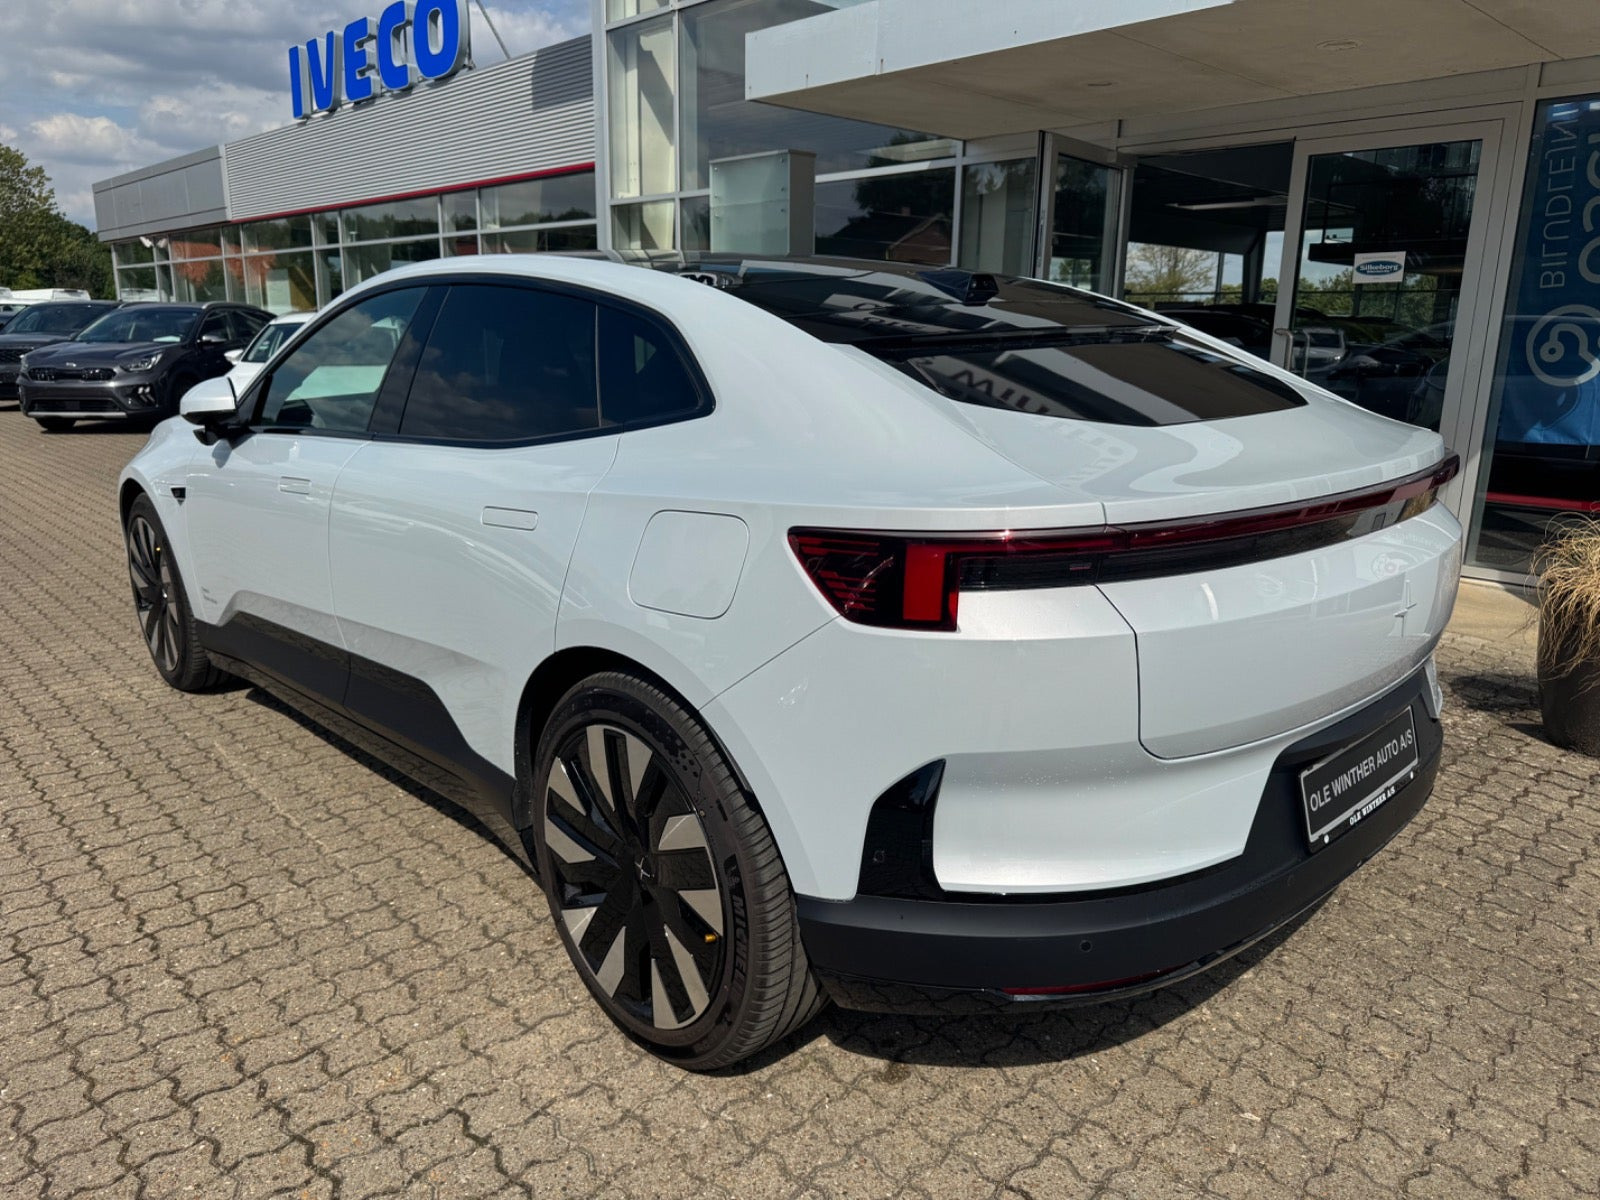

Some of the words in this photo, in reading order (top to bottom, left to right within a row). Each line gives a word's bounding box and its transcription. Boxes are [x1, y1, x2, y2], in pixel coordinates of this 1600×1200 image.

[289, 0, 462, 119] IVECO
[1310, 784, 1331, 812] OLE
[1331, 756, 1376, 797] WINTHER
[1376, 739, 1399, 769] AUTO
[1400, 728, 1413, 750] A/S
[1349, 810, 1362, 826] OLE
[1361, 792, 1387, 816] WINTHER
